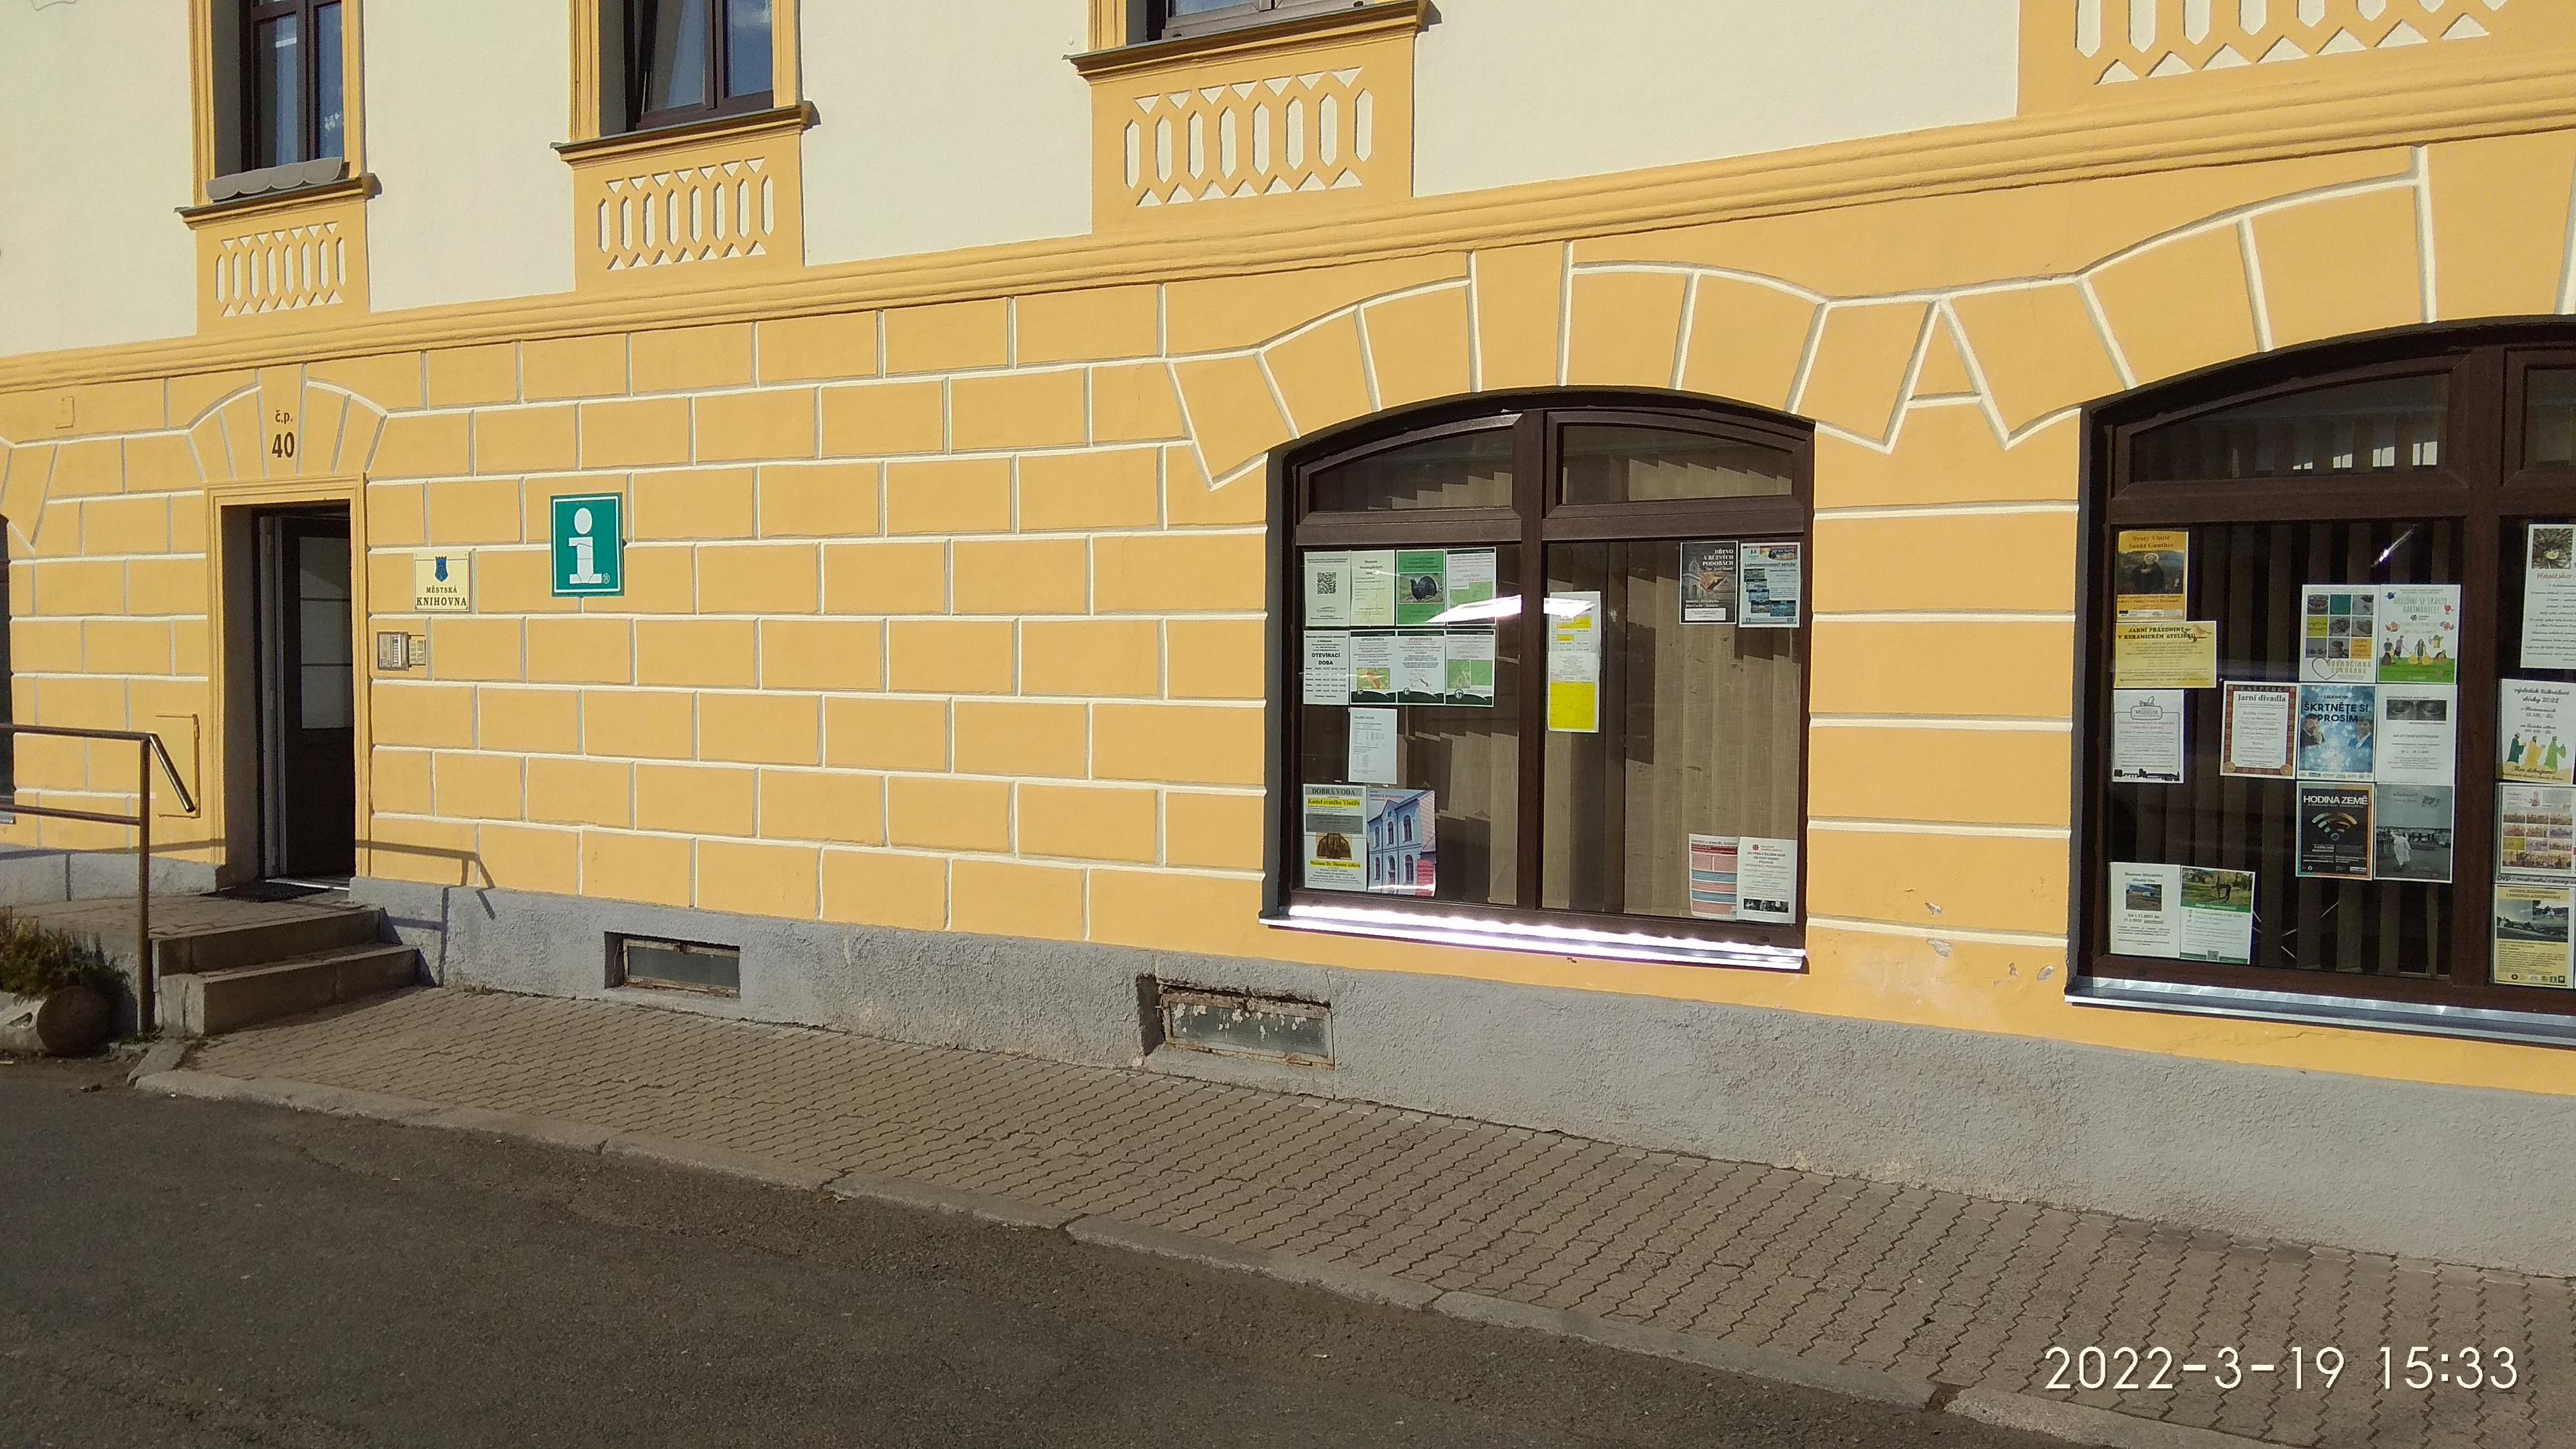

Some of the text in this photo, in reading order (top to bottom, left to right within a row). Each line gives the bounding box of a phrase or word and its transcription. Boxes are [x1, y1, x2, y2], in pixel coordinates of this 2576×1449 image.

[275, 410, 293, 424] č.p.
[272, 431, 295, 458] 40
[426, 585, 458, 594] MĚSTSKÁ
[416, 596, 468, 607] KNIHOVNA
[2304, 701, 2357, 712] ŠKRTNĚTE
[2317, 712, 2359, 723] PROSÍM
[2303, 795, 2369, 805] HODINA ZEMĚ
